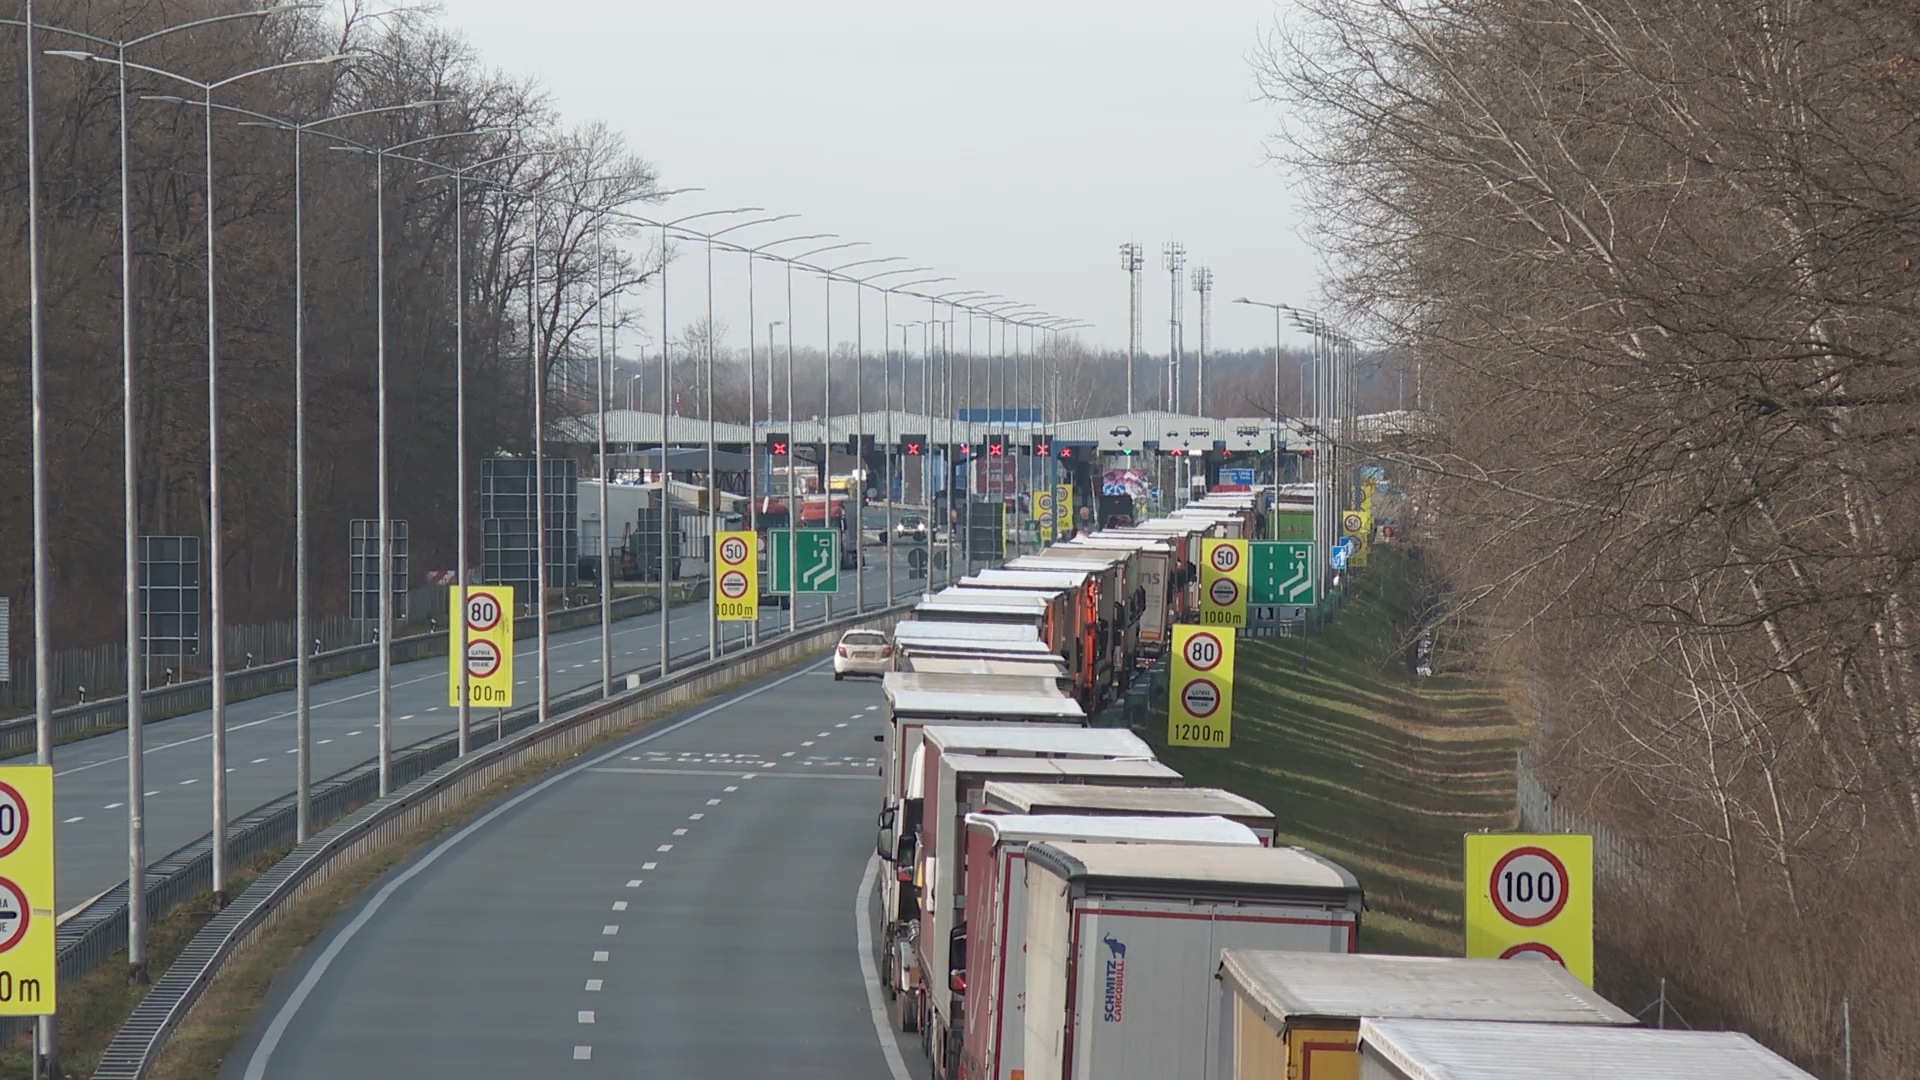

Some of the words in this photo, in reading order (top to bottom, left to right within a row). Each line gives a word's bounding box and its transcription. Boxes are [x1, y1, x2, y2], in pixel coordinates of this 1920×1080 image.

[1348, 519, 1359, 528] 50
[726, 544, 742, 559] 50
[1217, 551, 1233, 566] 50
[471, 603, 493, 622] 80
[1192, 642, 1214, 662] 80
[456, 685, 506, 702] 100m
[1504, 871, 1555, 902] 100
[1104, 960, 1117, 1022] SCHMITZ
[1114, 961, 1125, 1022] CARGOBULL
